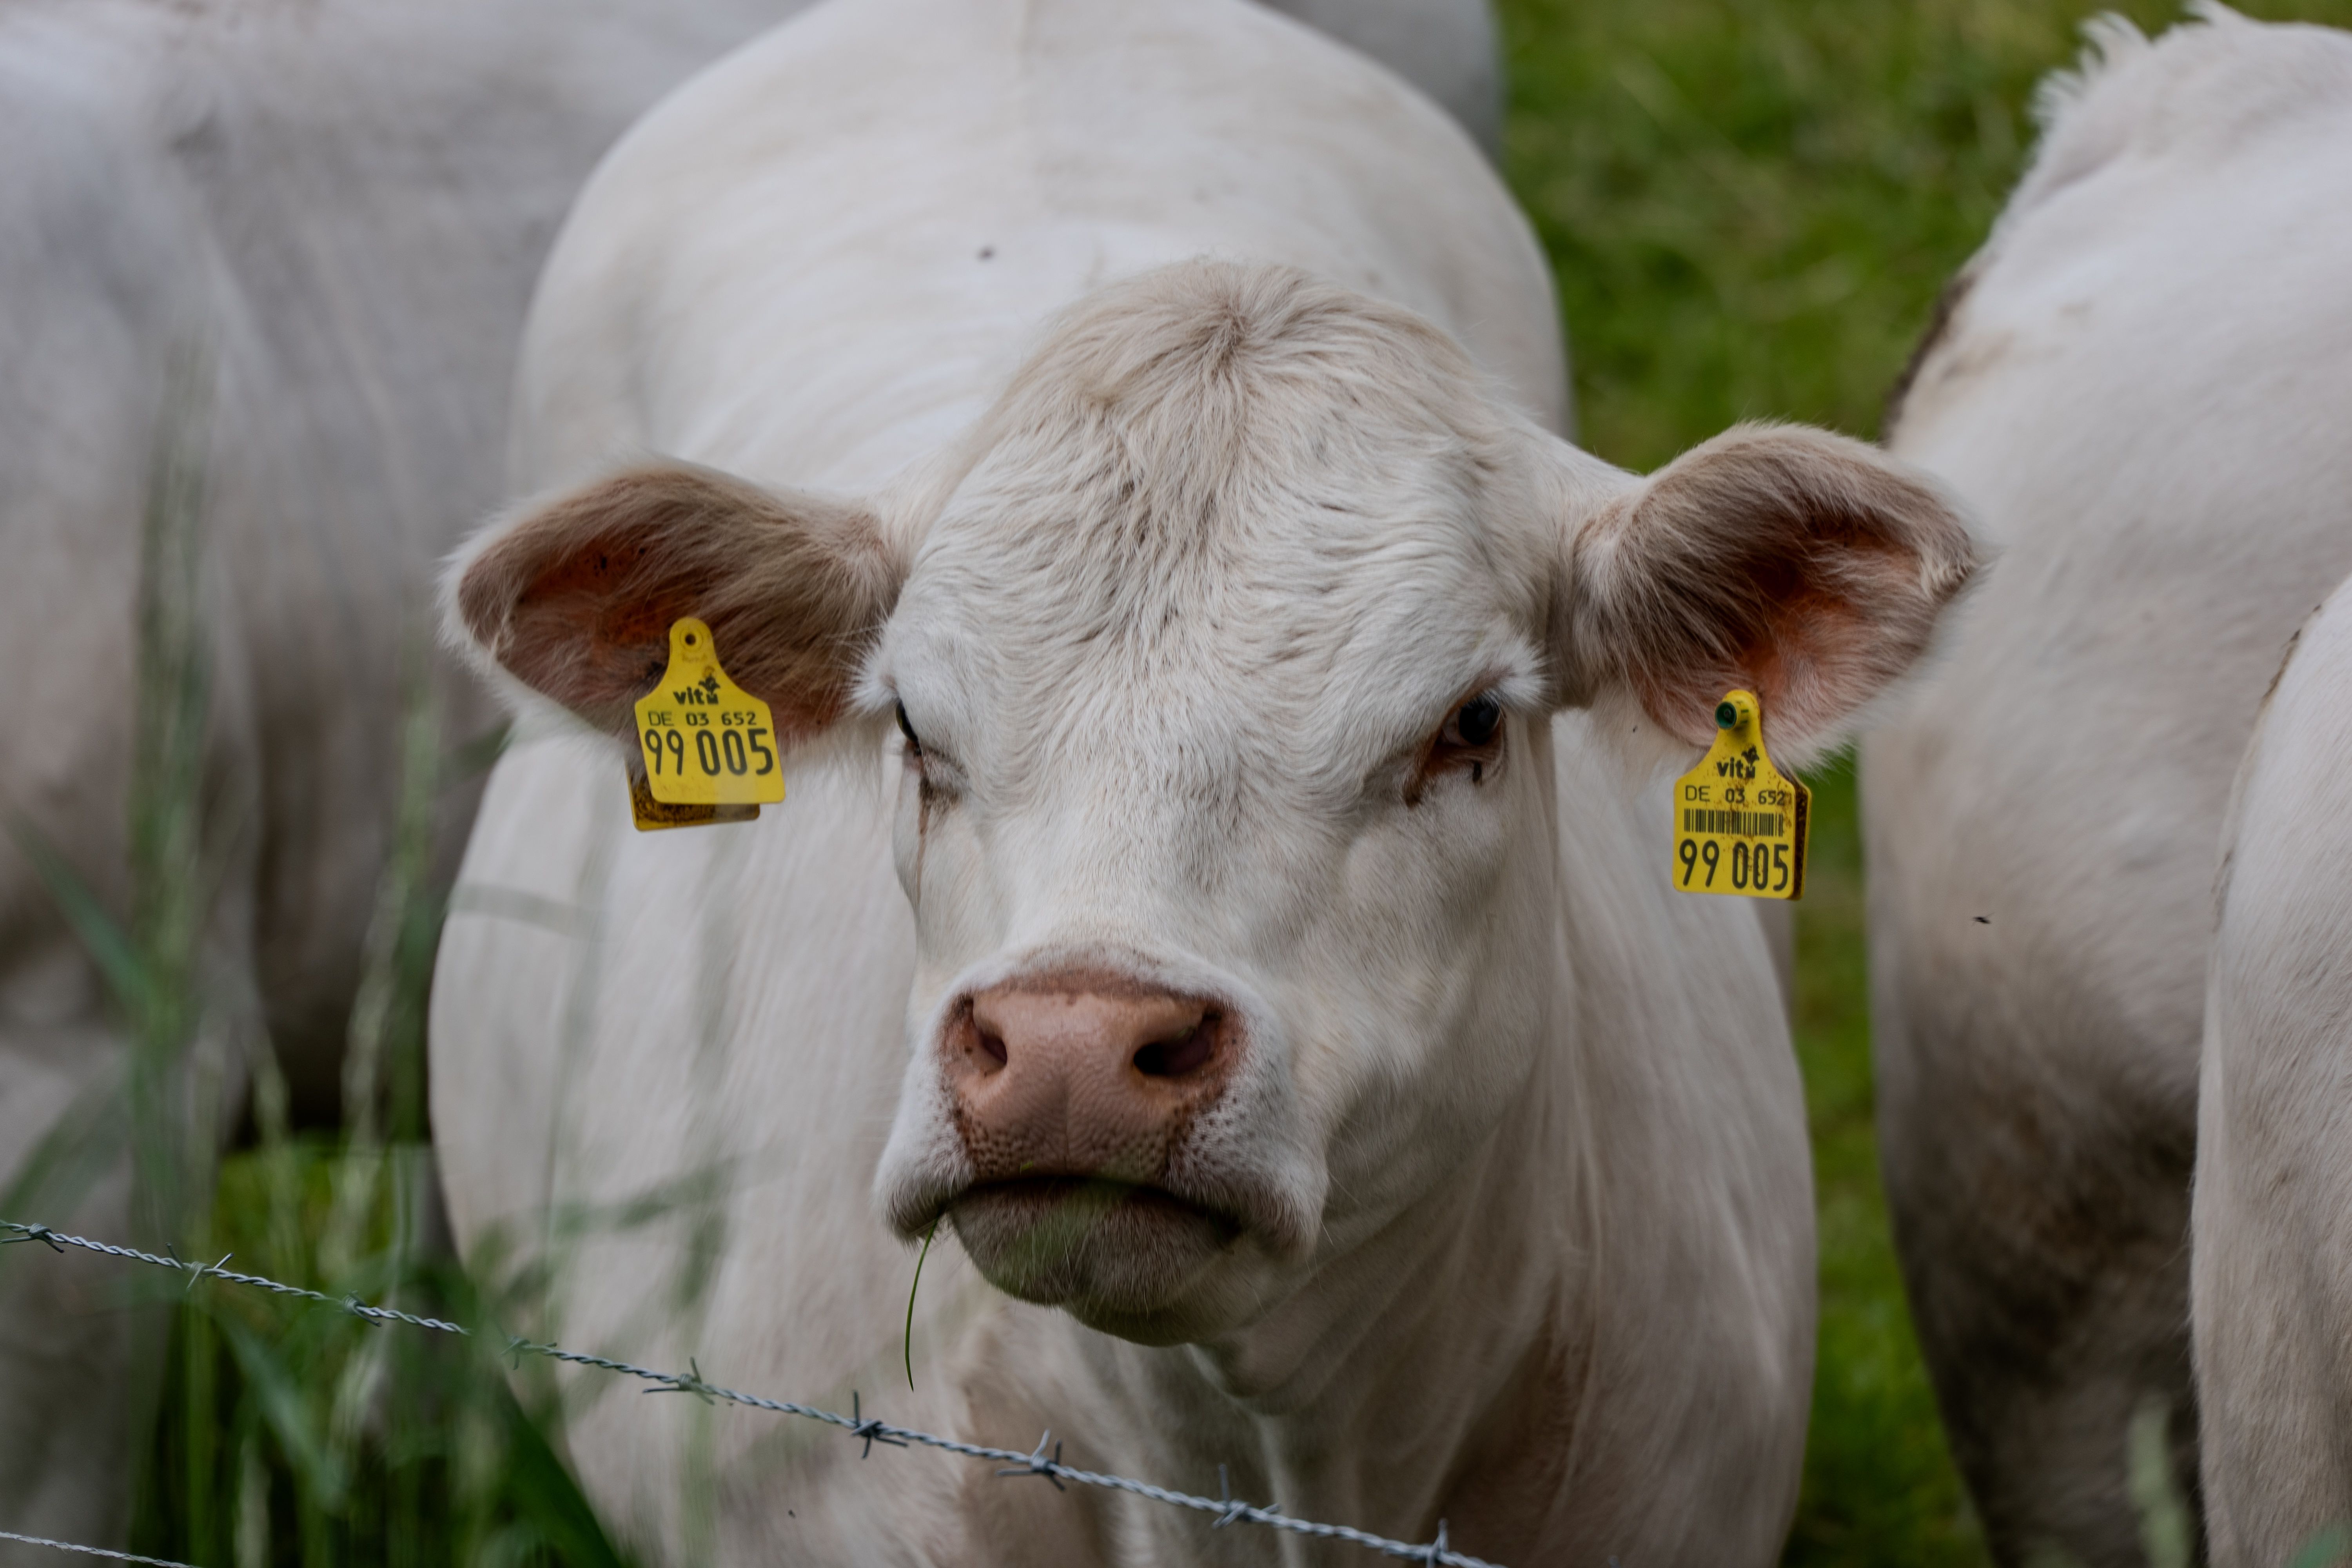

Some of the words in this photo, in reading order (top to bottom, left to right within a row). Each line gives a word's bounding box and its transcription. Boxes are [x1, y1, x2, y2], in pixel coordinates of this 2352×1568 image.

[648, 711, 674, 726] DE
[686, 712, 709, 726] 03
[721, 711, 757, 726] 652
[644, 729, 684, 775] 99
[695, 728, 773, 776] 005
[1716, 756, 1743, 779] vit
[1685, 785, 1710, 802] DE
[1725, 788, 1745, 804] 03
[1758, 789, 1785, 806] 652
[1679, 838, 1720, 887] 99
[1732, 841, 1789, 892] 005
